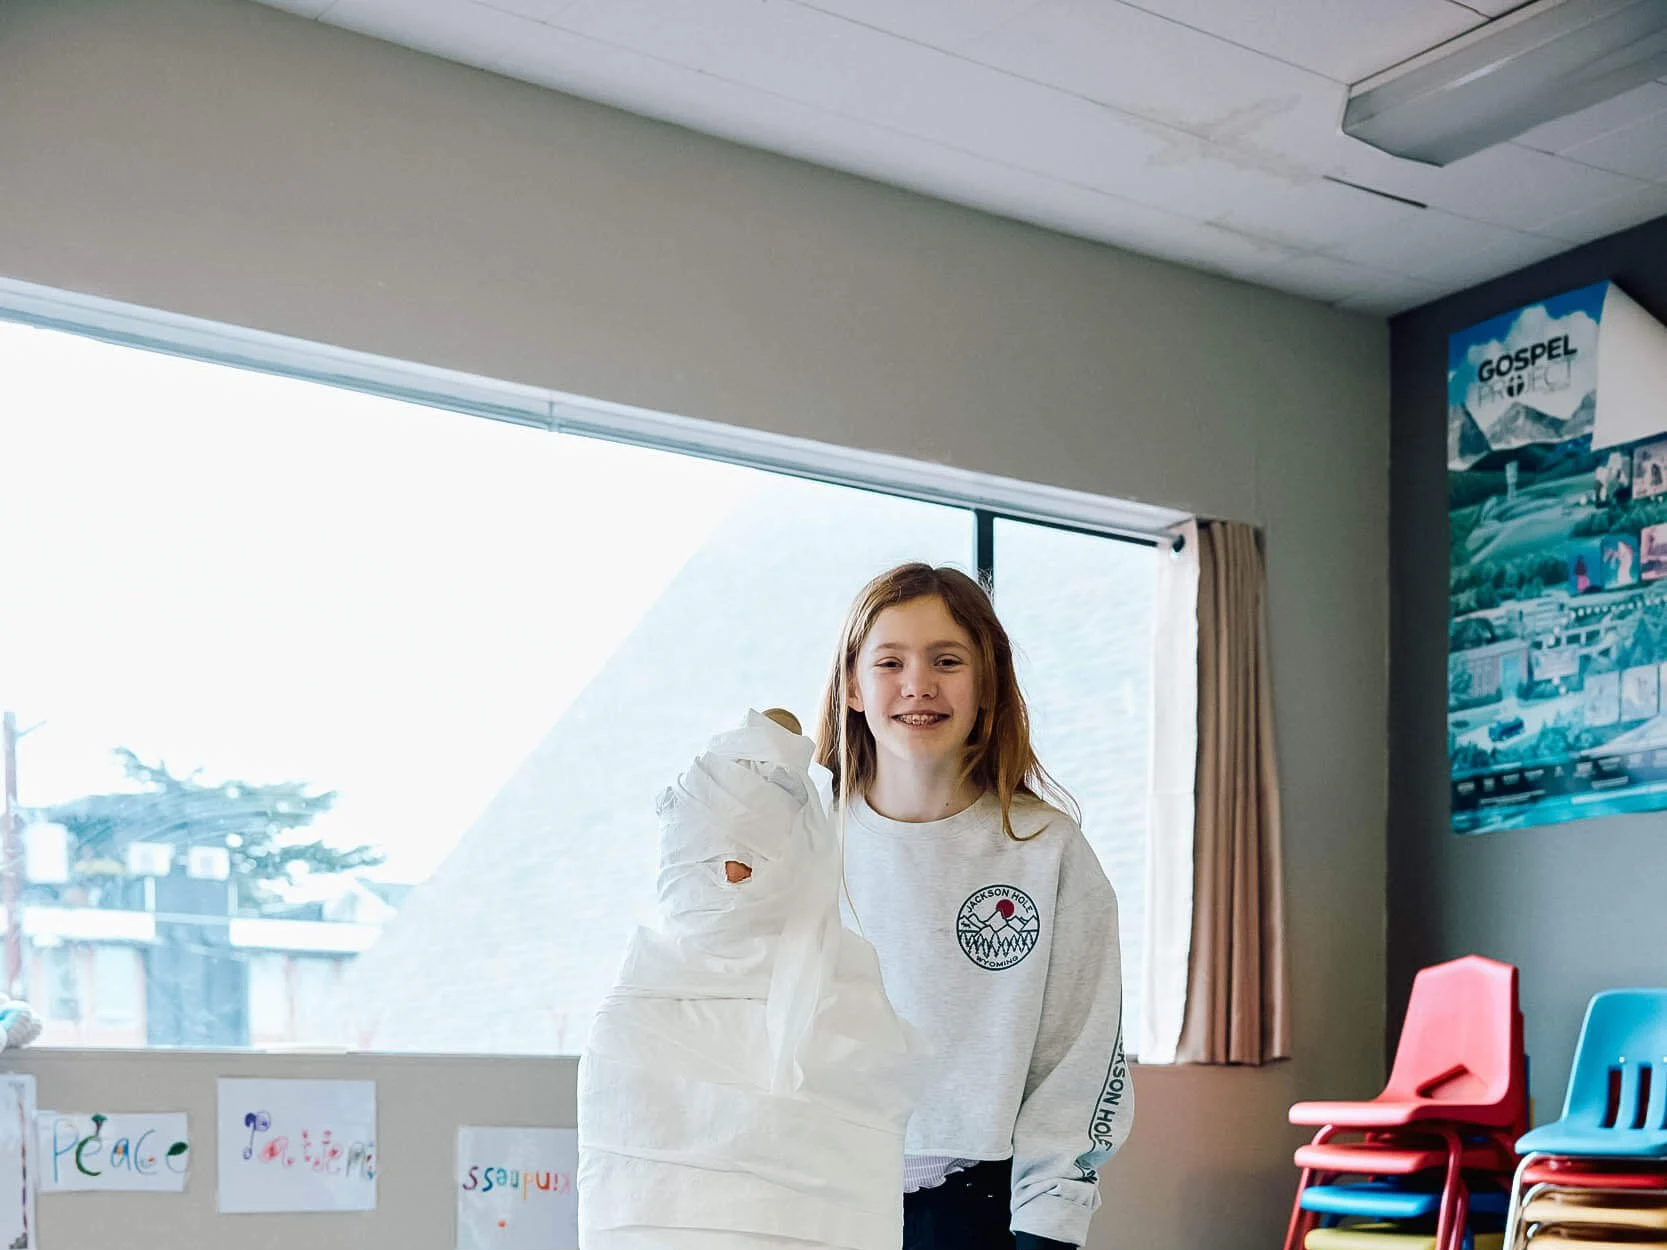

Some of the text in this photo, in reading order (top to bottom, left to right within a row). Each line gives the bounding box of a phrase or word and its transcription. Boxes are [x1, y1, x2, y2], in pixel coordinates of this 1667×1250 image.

[1478, 334, 1578, 382] GOSPEL
[966, 888, 1033, 913] JACKSON HOLE
[976, 955, 1019, 967] WYOMING
